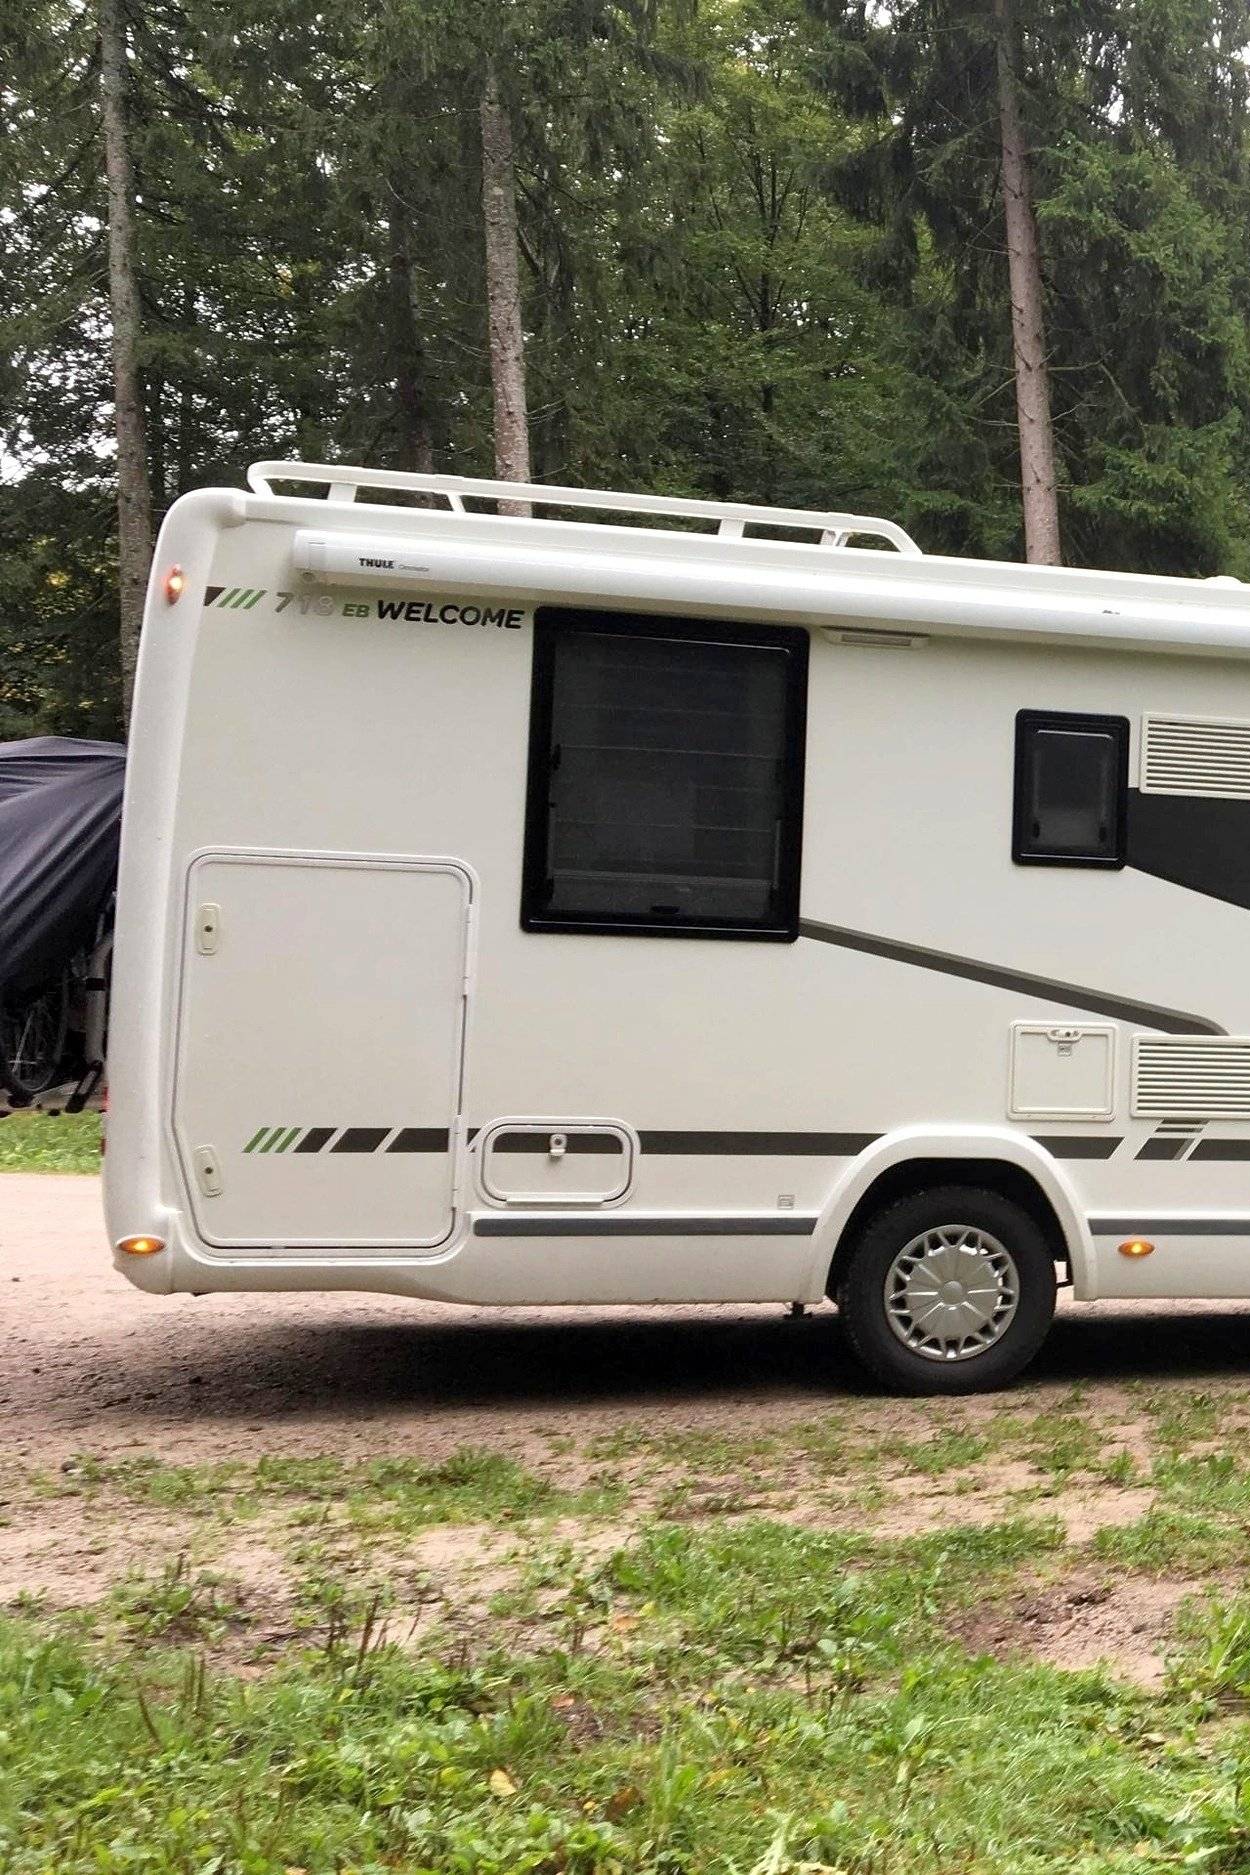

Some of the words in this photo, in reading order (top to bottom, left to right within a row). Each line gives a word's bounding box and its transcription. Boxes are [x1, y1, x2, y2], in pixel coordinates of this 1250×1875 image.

[359, 557, 395, 569] THULE
[342, 603, 370, 618] EB
[377, 599, 525, 629] WELCOME
